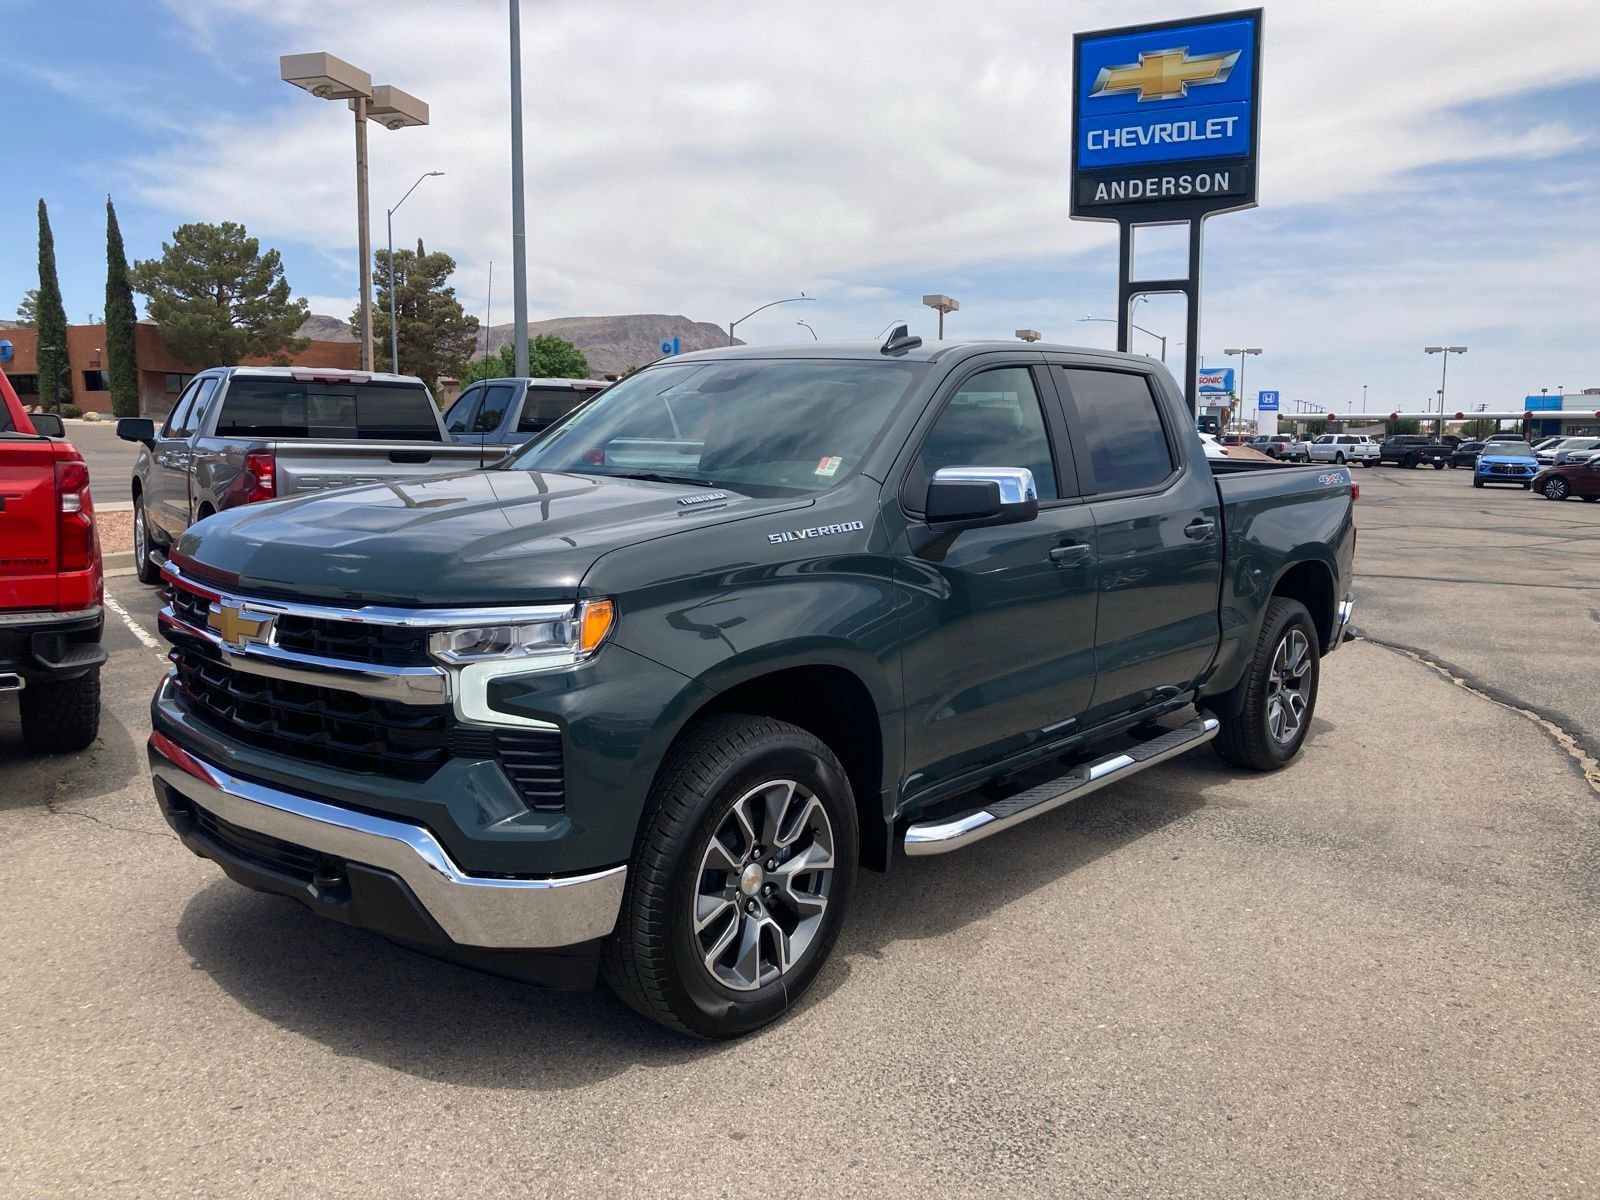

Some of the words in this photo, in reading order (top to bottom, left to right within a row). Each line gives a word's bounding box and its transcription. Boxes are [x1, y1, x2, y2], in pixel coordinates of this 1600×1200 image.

[1087, 116, 1239, 150] CHEVROLET
[1095, 172, 1230, 201] ANDERSON
[1199, 376, 1223, 385] SONIC
[767, 520, 864, 545] SILVERADO
